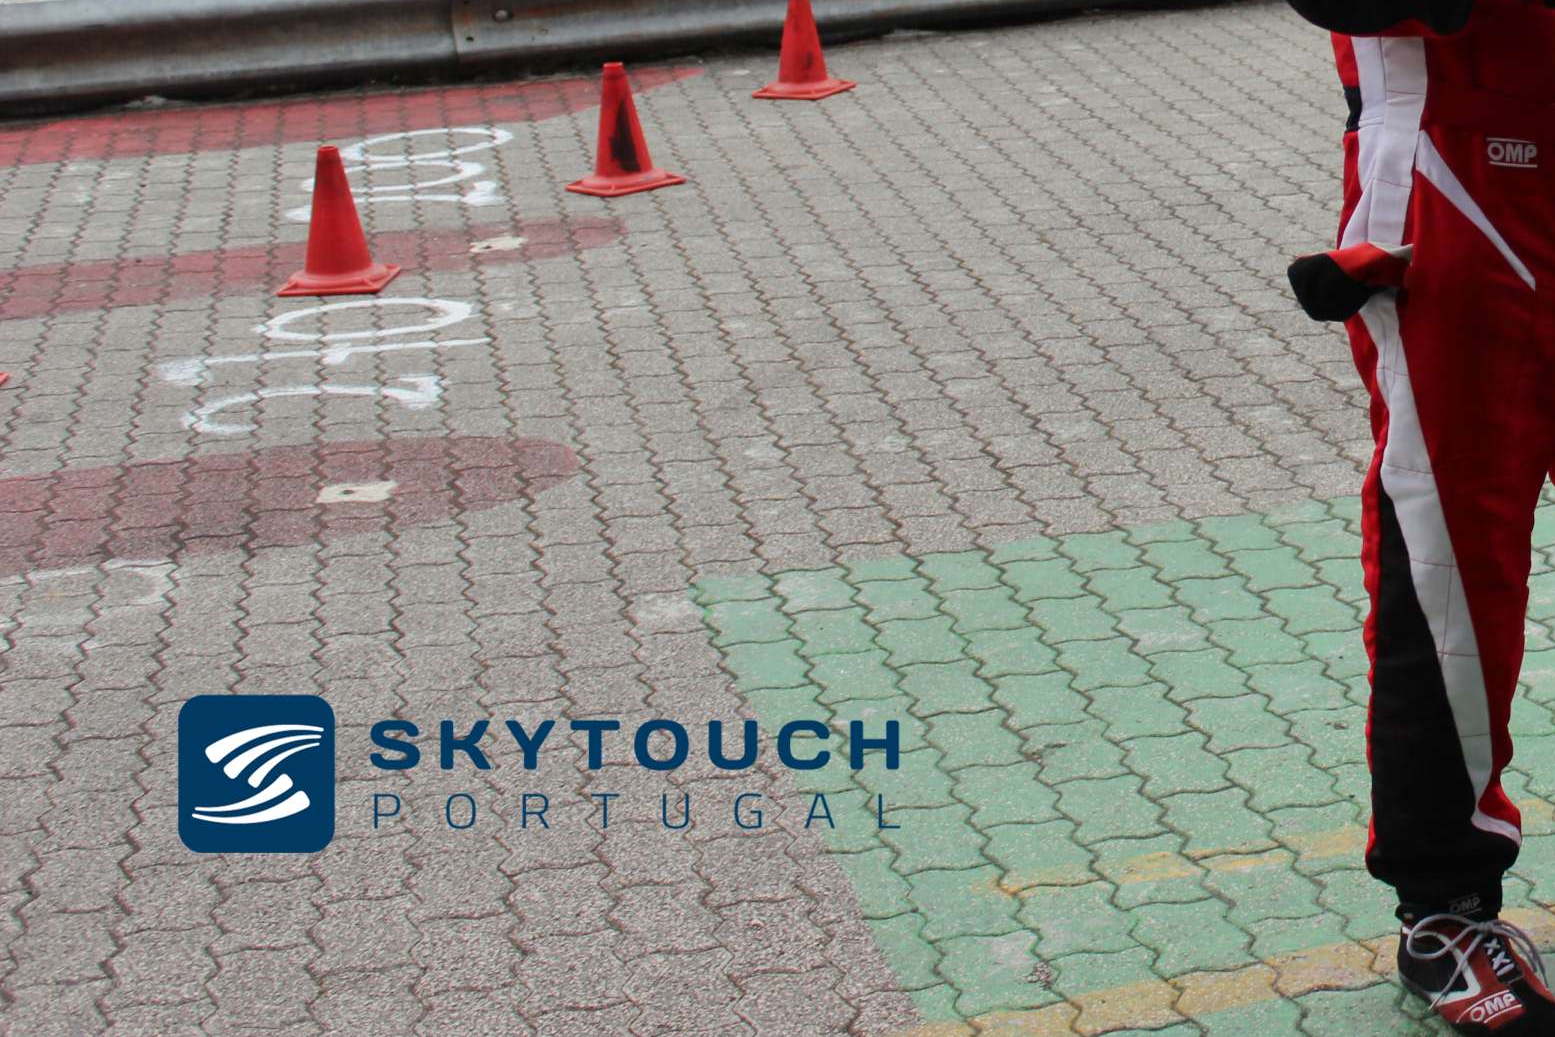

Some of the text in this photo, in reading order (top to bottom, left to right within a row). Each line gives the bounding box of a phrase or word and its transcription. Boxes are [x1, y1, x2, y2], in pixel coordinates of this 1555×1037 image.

[1487, 141, 1537, 163] OMP
[1450, 896, 1481, 913] OMP
[1470, 992, 1516, 1022] OMP
